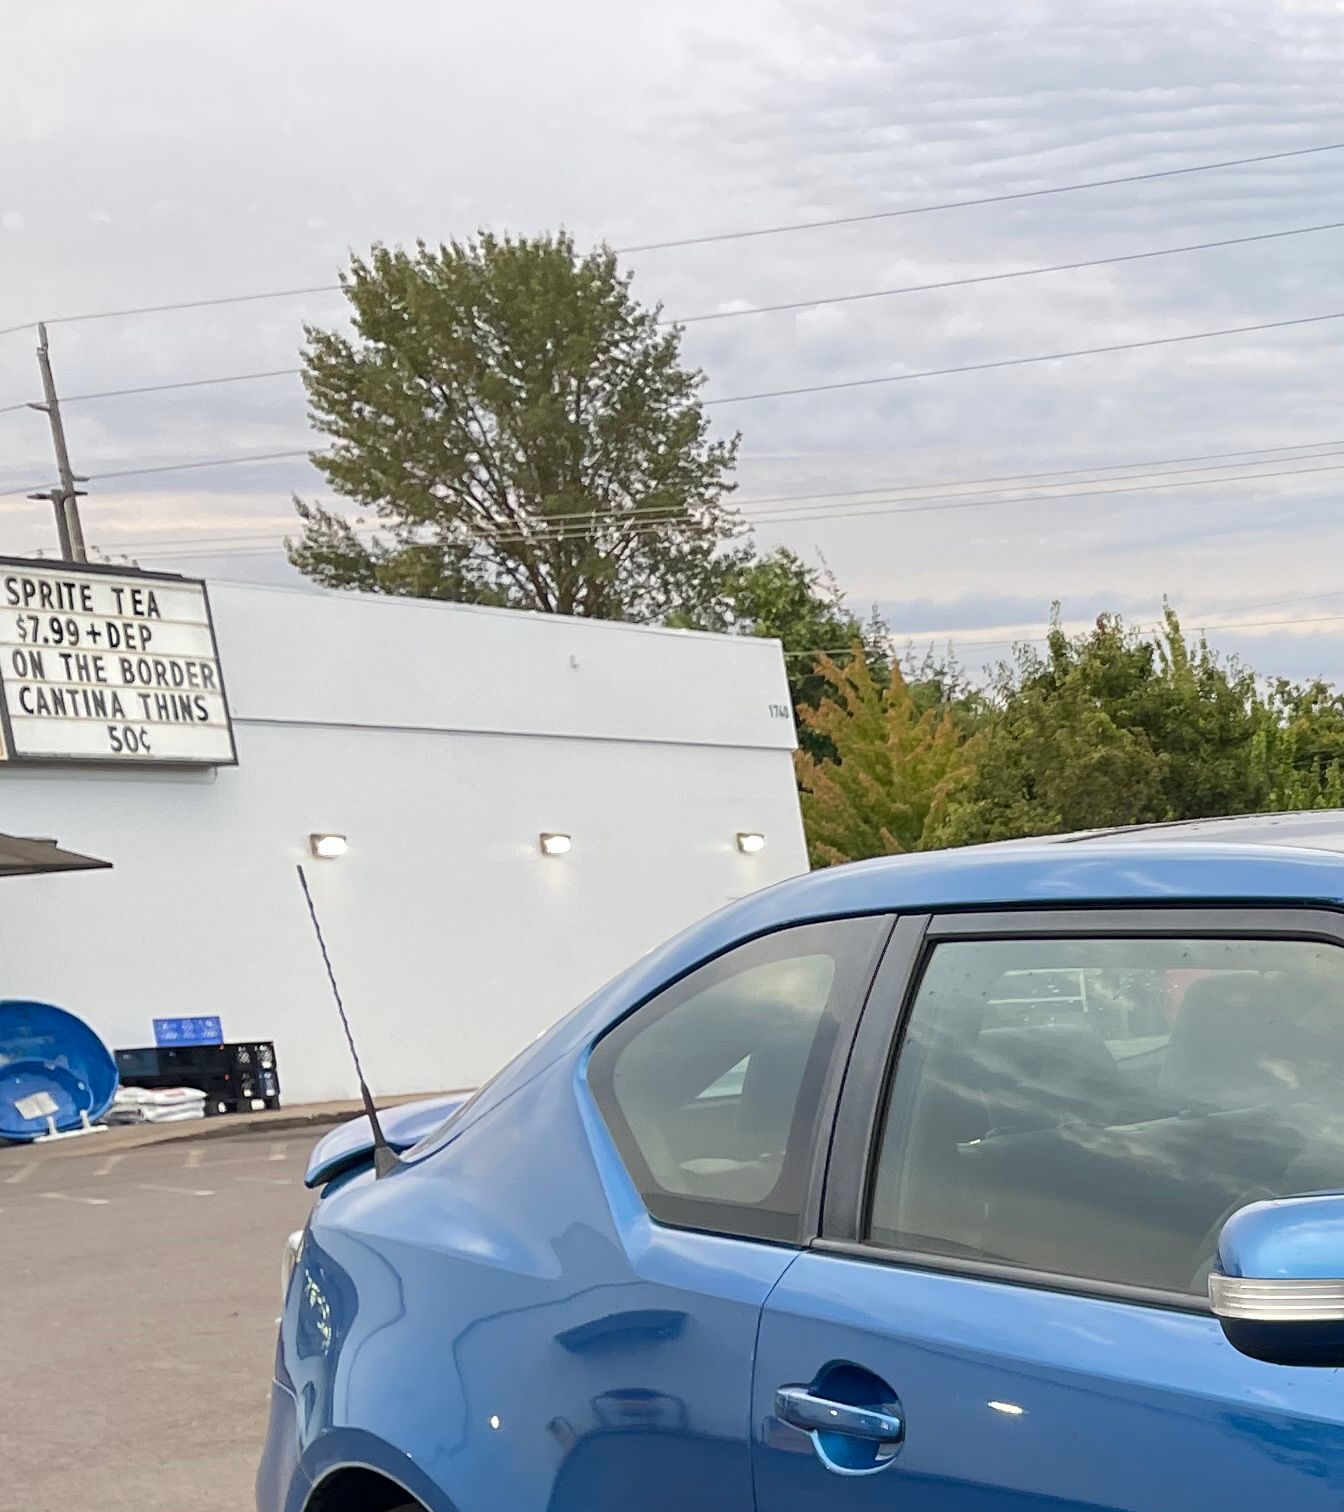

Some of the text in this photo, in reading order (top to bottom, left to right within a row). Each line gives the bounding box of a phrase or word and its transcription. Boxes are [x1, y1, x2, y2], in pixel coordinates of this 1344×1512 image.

[4, 576, 162, 619] SPRITE TEA
[12, 650, 217, 689] ON THE BORDER
[19, 686, 209, 722] CANTINA THINS
[107, 725, 151, 753] 50¢
